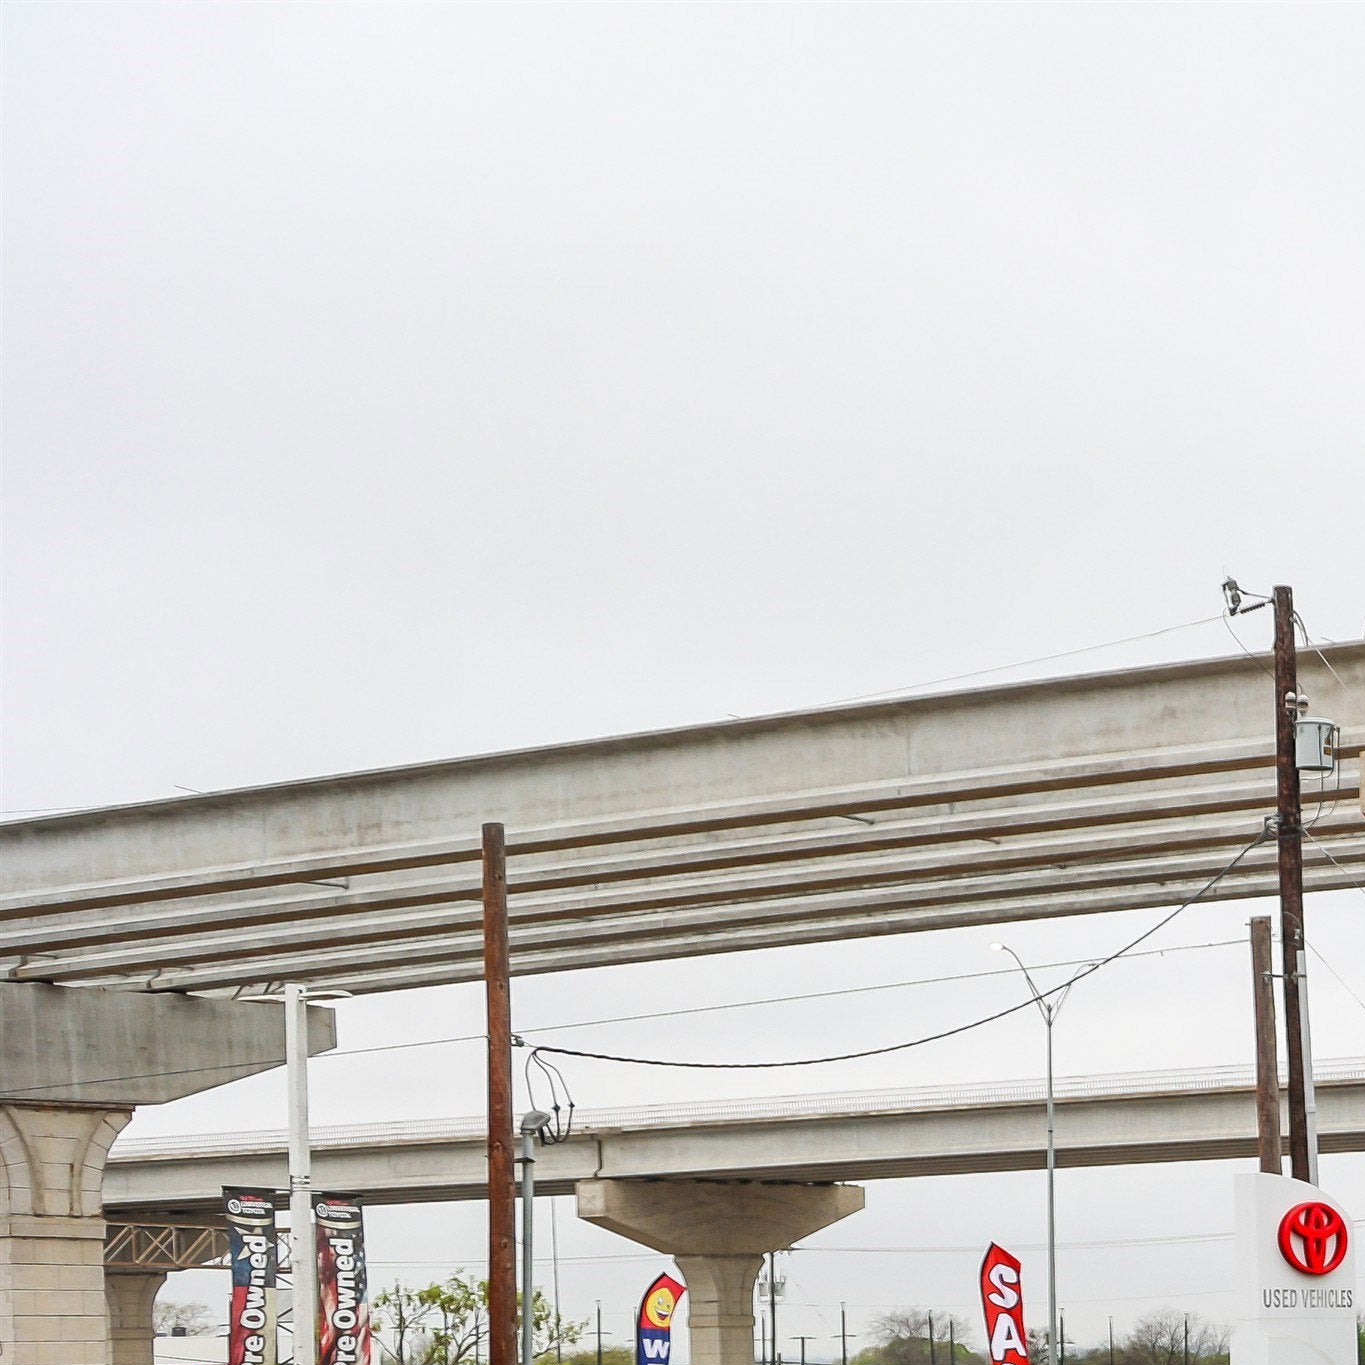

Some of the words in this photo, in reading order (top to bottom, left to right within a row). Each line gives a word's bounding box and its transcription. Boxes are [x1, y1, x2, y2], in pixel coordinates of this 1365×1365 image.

[240, 1235, 268, 1329] Owned
[329, 1238, 358, 1329] Owned
[1263, 1288, 1297, 1308] USED
[1301, 1288, 1353, 1308] VEHICLES
